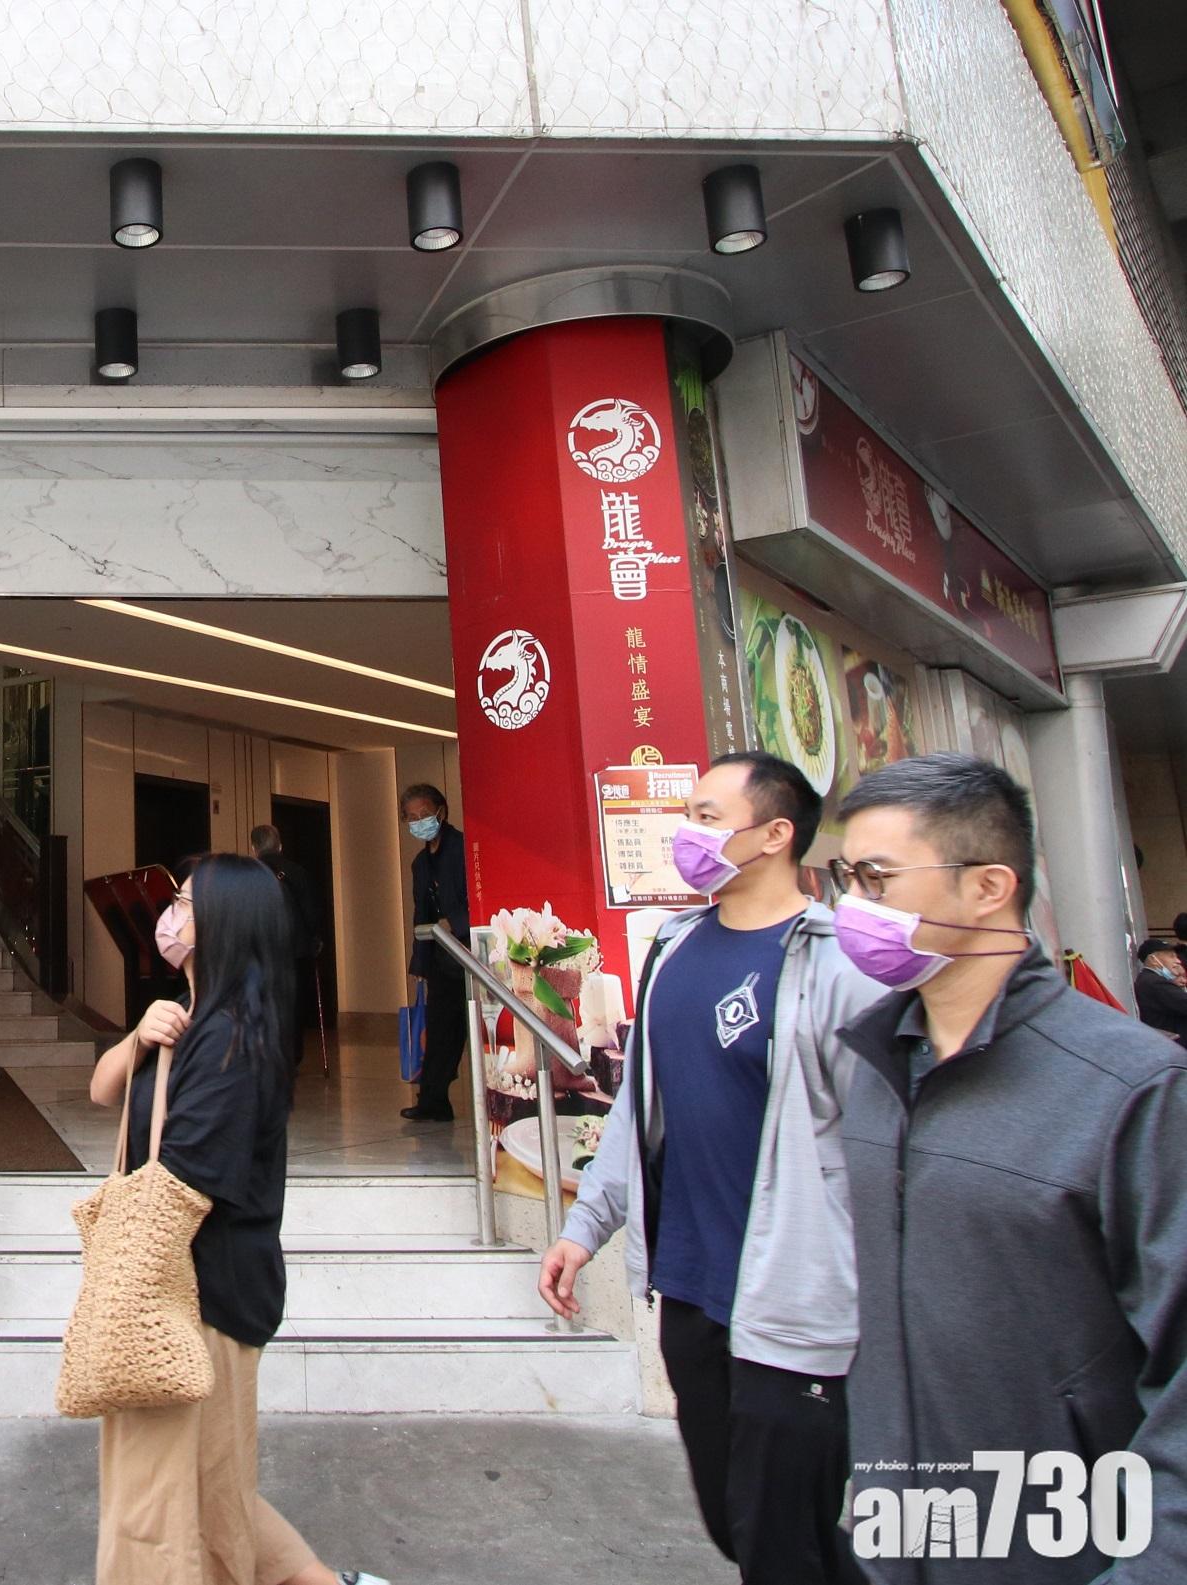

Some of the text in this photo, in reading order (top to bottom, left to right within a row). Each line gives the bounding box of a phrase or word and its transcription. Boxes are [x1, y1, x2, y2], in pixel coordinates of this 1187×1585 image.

[602, 537, 682, 566] Dragon Place
[625, 626, 654, 728] 龍情盛宴
[647, 771, 694, 800] 招聘
